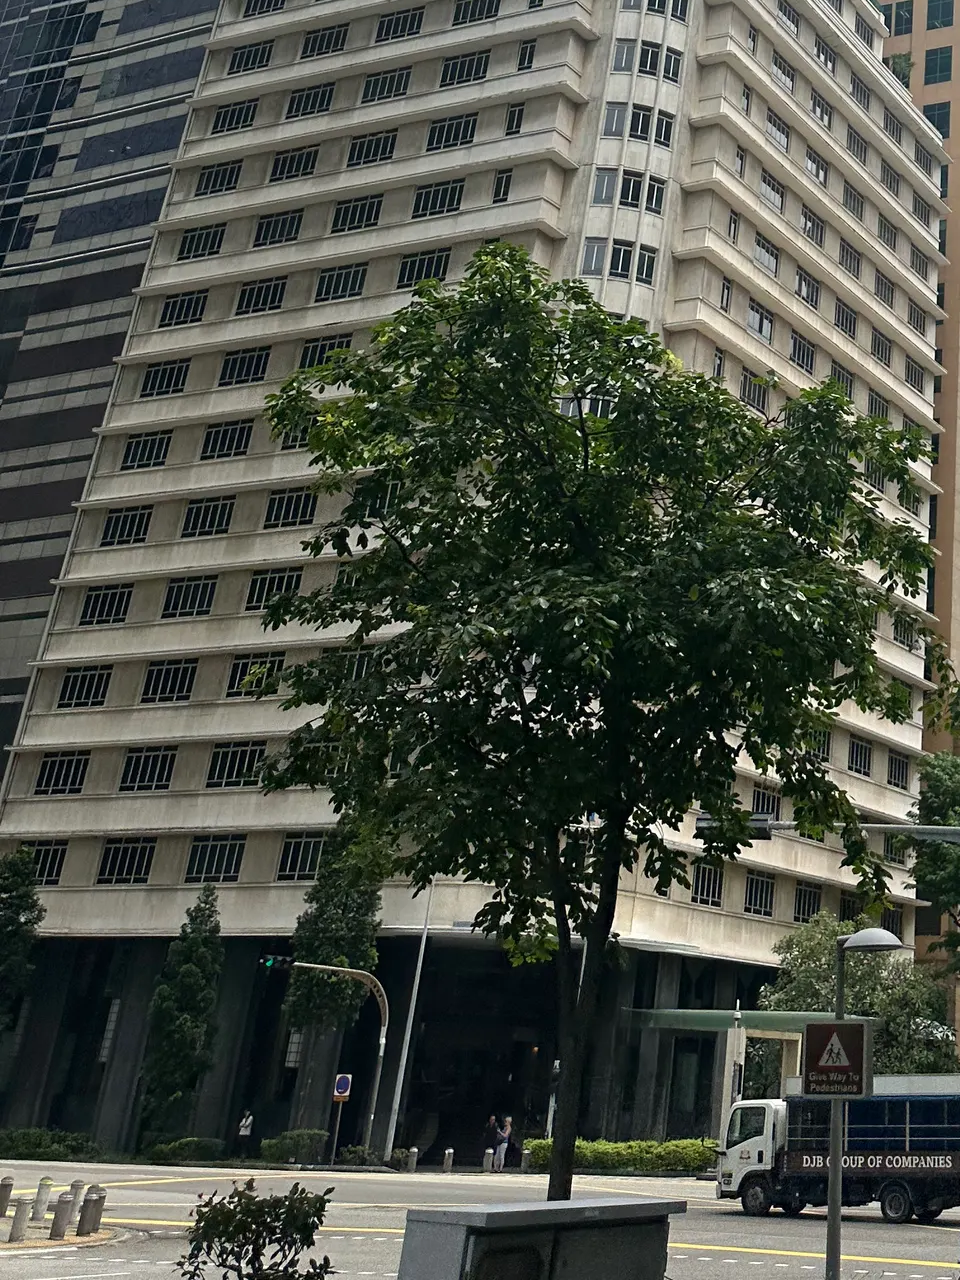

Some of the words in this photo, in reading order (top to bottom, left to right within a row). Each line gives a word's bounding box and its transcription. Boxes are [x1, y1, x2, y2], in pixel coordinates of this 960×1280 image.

[809, 1072, 828, 1081] Give
[829, 1072, 847, 1082] Way
[849, 1072, 860, 1081] To
[810, 1082, 859, 1092] Pedestrians
[802, 1155, 824, 1168] DJB
[826, 1155, 865, 1168] OUP
[867, 1155, 883, 1168] OF
[885, 1154, 953, 1169] COMPANIES
